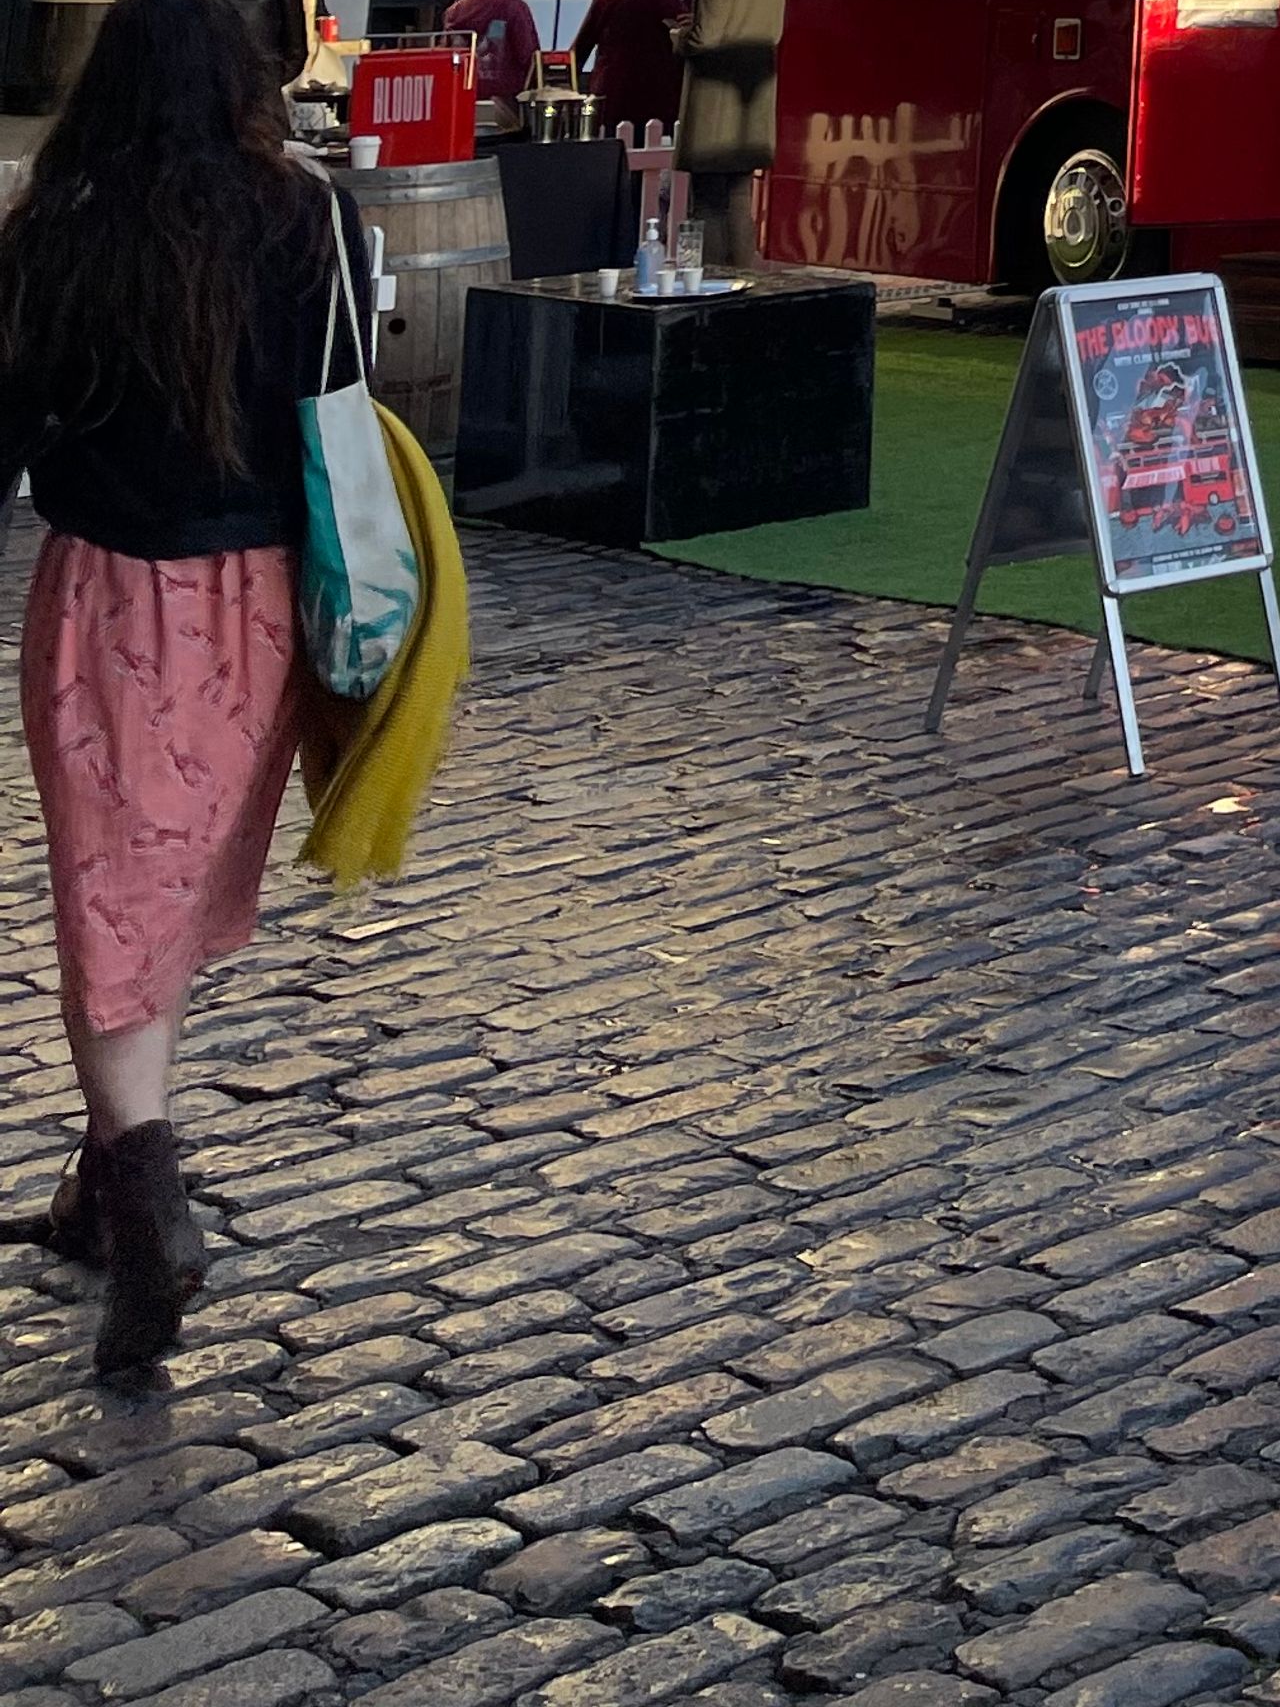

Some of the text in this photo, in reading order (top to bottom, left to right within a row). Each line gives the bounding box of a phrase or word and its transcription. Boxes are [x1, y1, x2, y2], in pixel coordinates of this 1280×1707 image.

[373, 74, 434, 124] BLOODY
[1076, 324, 1110, 364] THE
[1111, 315, 1180, 351] BLOODY
